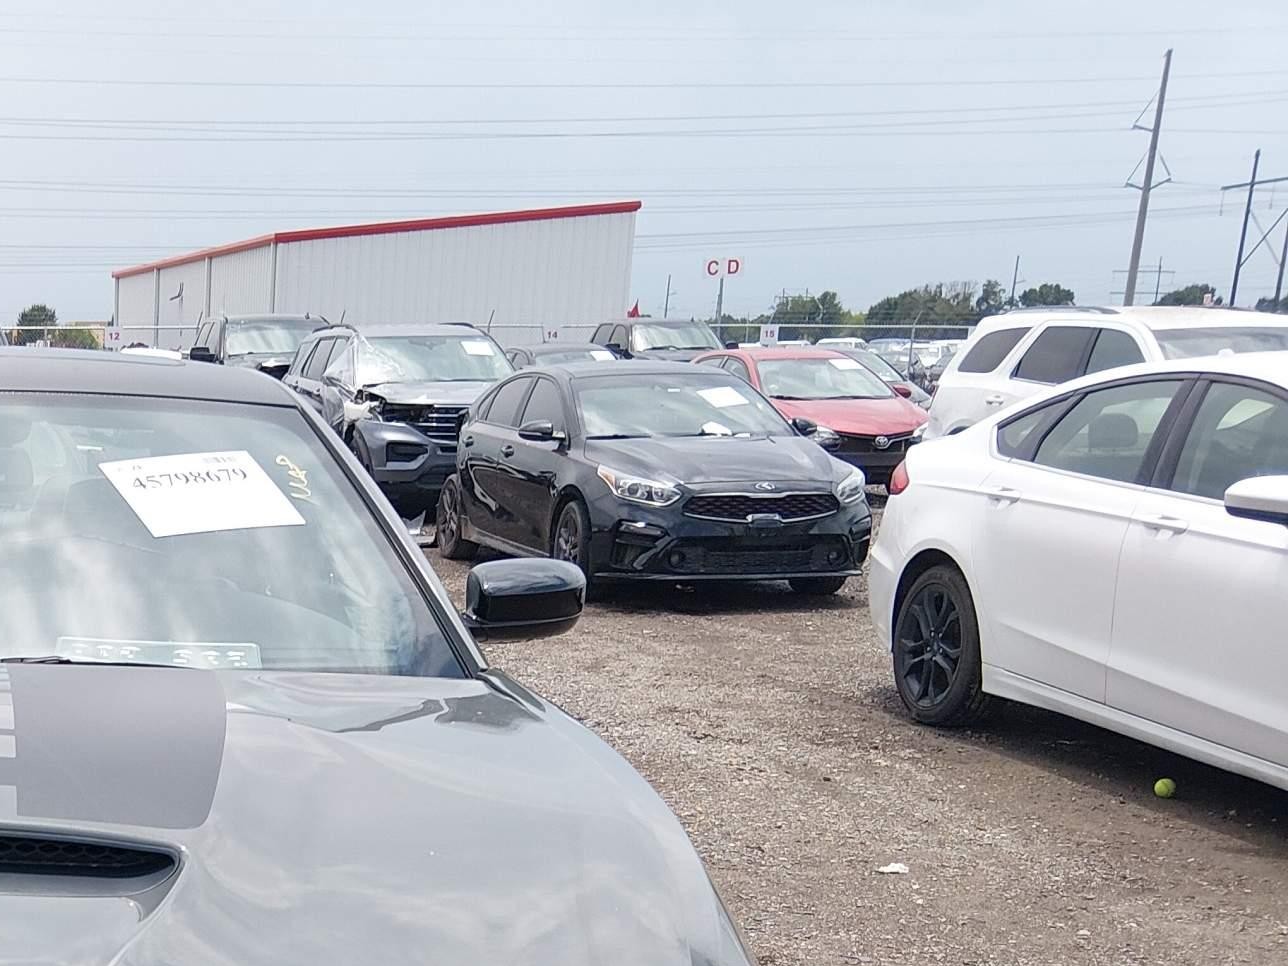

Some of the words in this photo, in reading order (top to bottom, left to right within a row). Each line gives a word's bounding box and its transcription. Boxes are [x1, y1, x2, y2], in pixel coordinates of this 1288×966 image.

[707, 260, 719, 276] C
[727, 259, 740, 274] D
[109, 332, 120, 341] 12
[547, 331, 558, 339] 14
[765, 330, 775, 338] 15
[132, 467, 248, 489] 45798679
